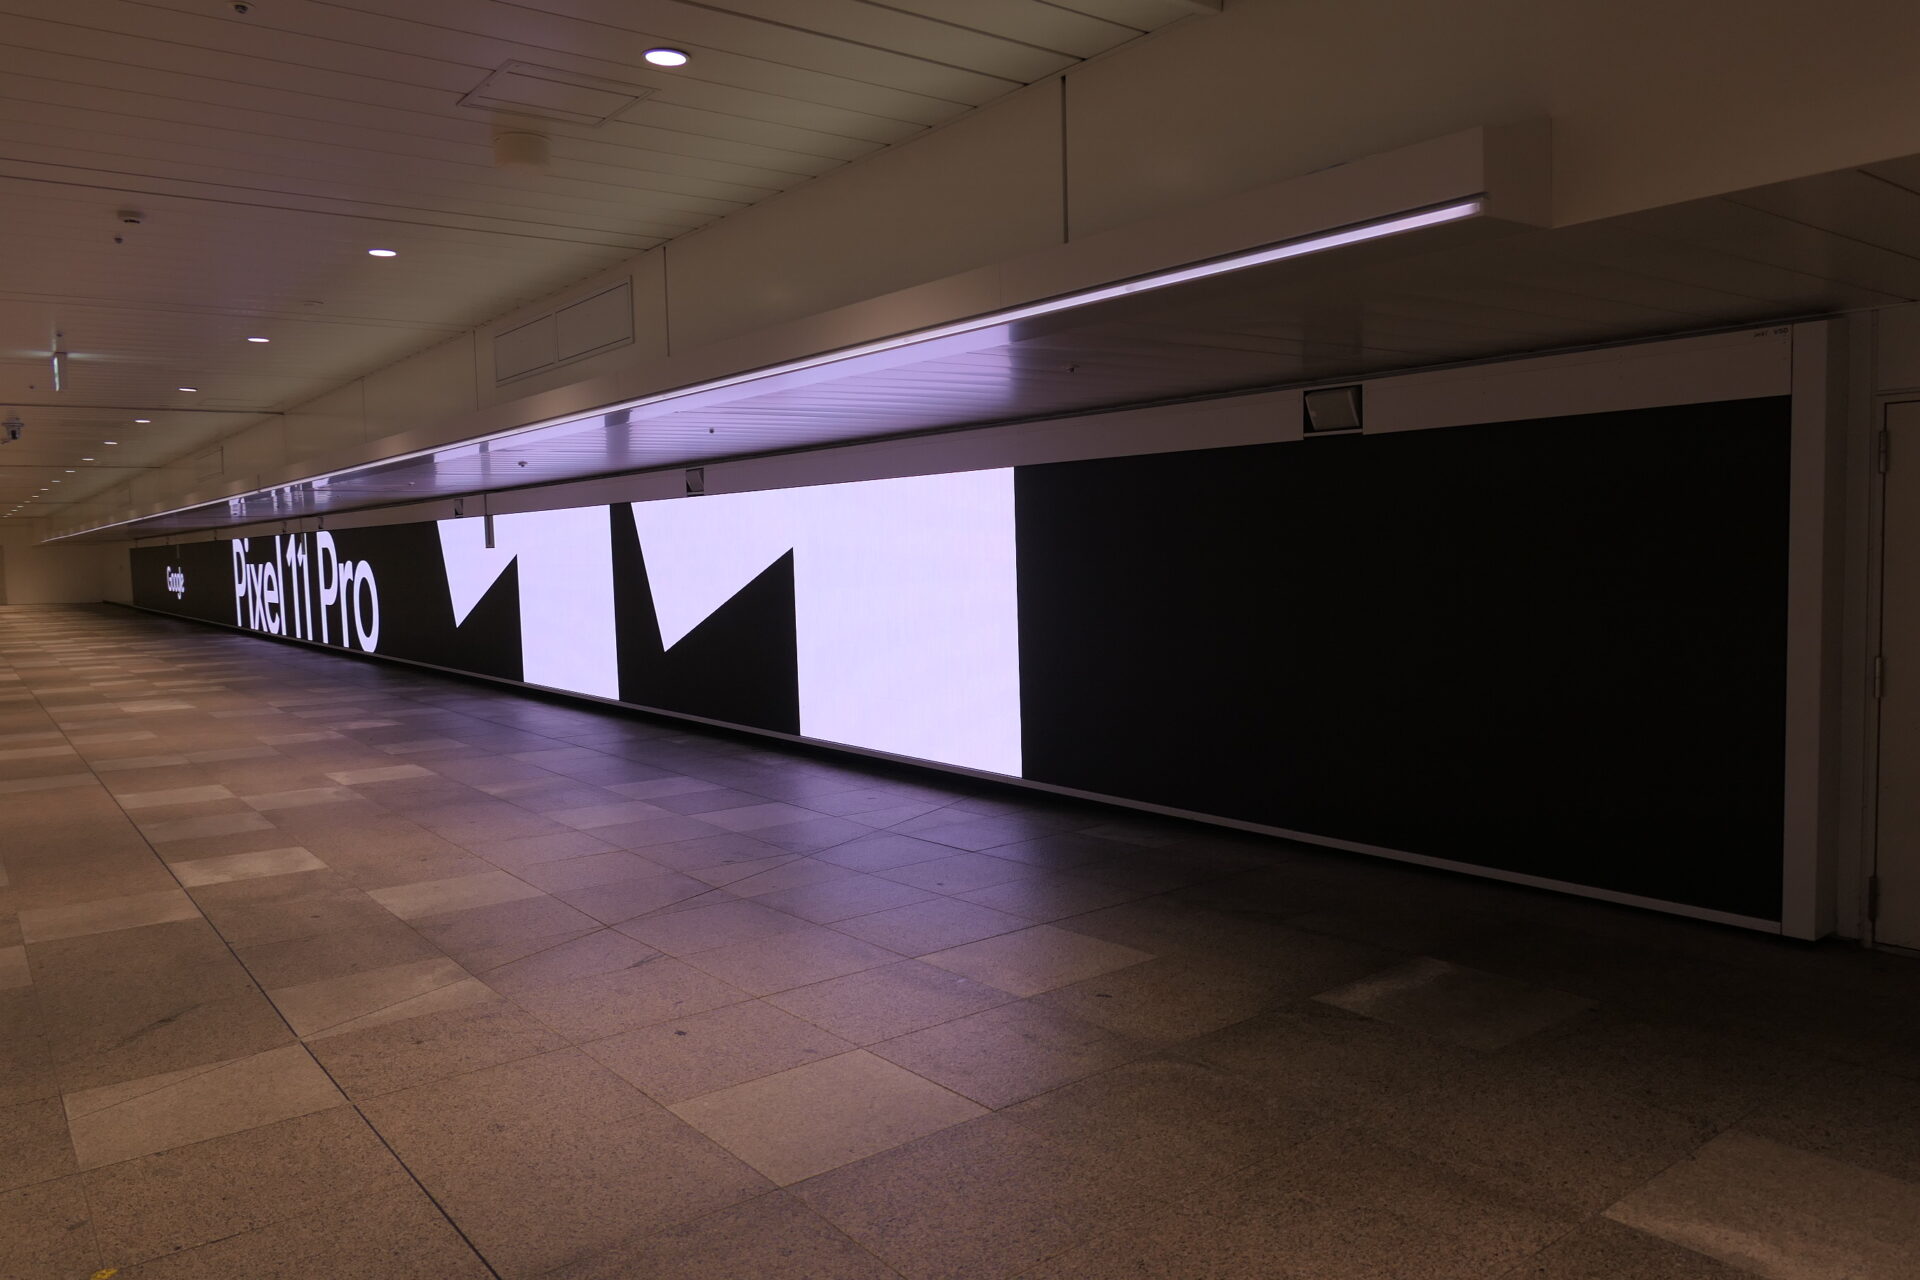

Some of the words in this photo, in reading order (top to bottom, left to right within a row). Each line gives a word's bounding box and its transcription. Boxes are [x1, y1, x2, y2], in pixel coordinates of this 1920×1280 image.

[166, 565, 185, 600] Google
[231, 534, 287, 636] Pixel
[285, 532, 313, 641] 11
[316, 530, 380, 653] Pro
